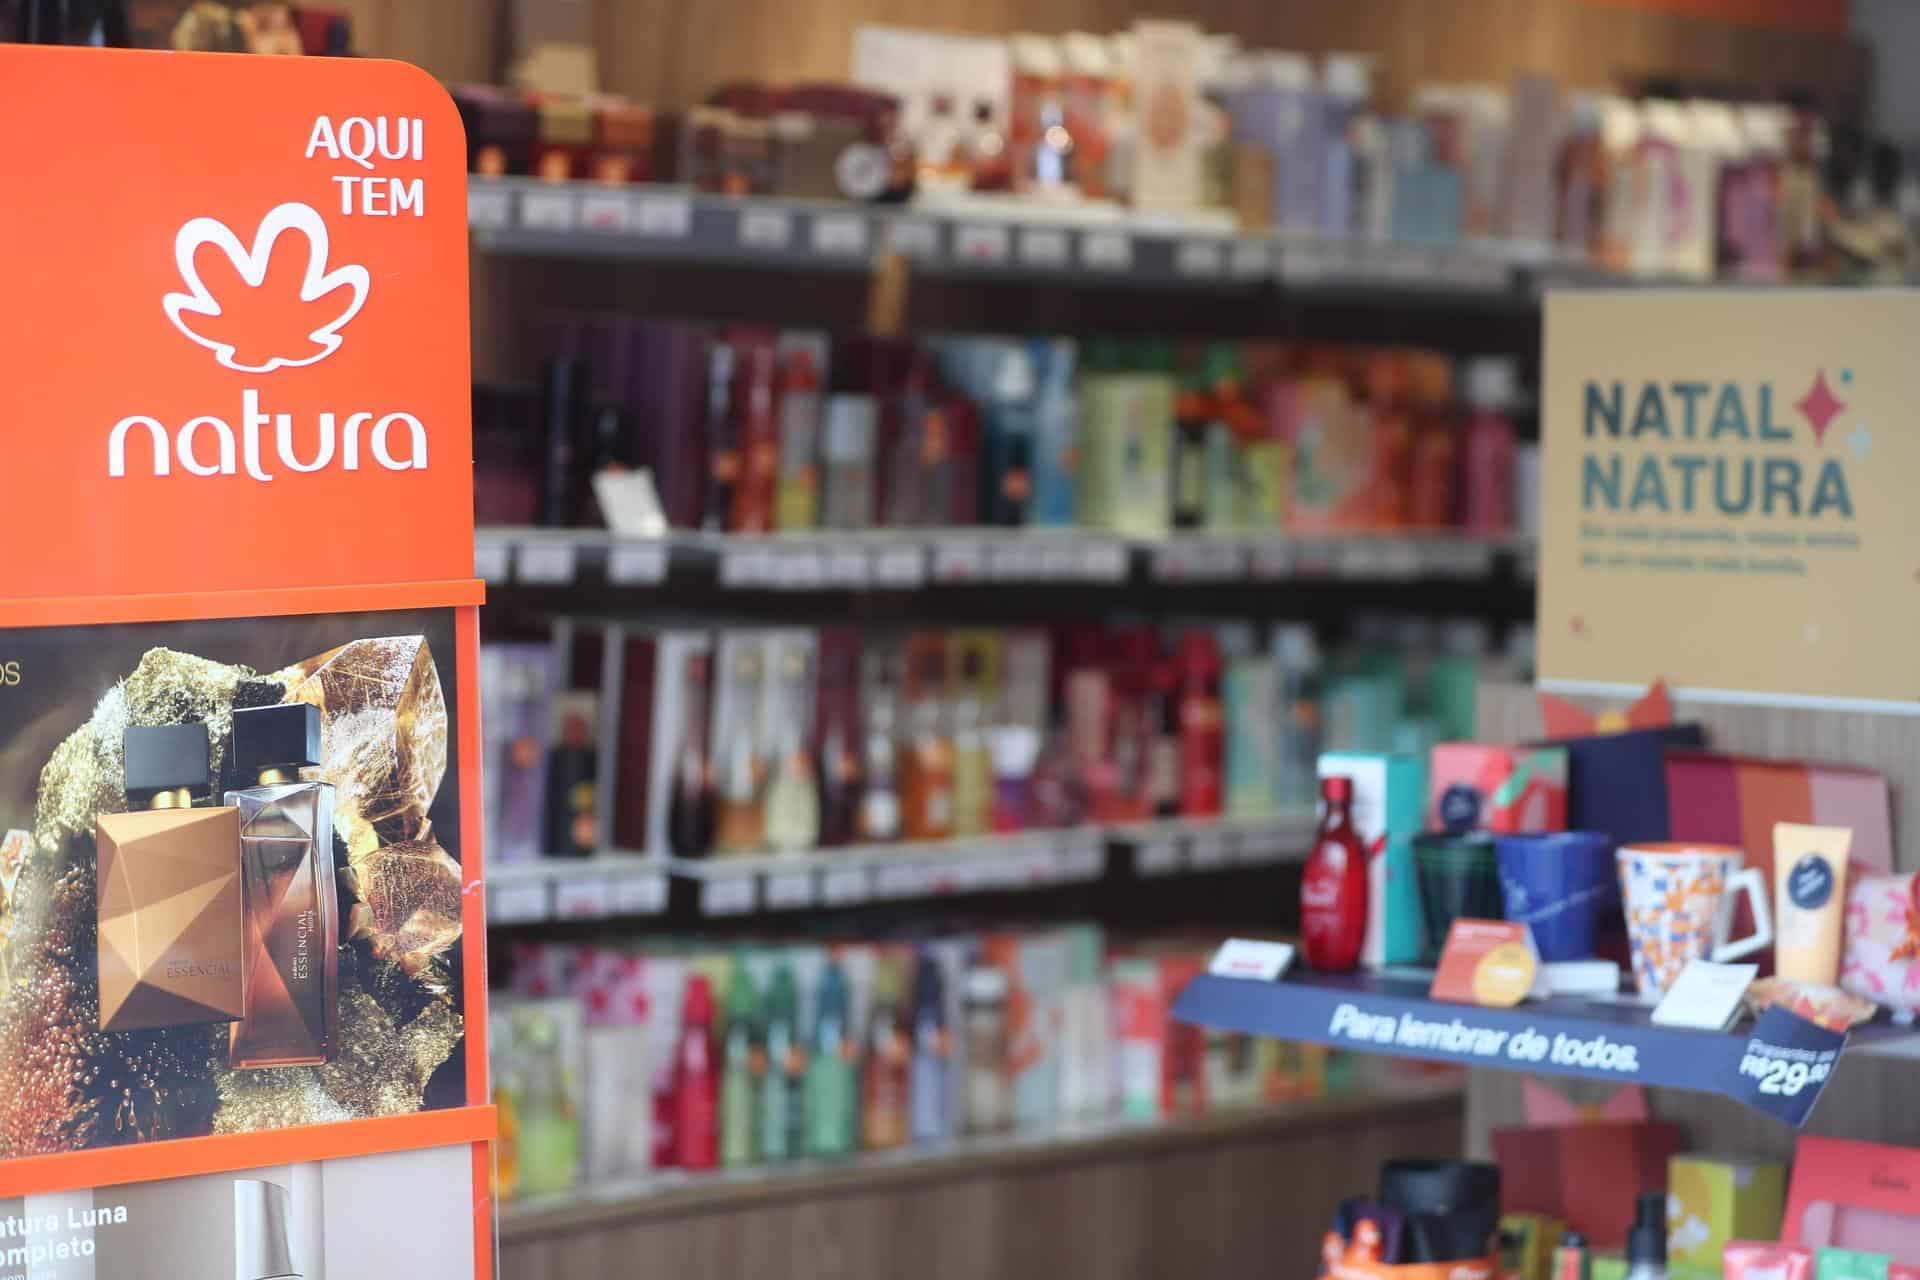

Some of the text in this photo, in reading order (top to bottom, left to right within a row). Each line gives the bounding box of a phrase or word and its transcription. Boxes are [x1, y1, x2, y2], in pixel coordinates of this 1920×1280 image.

[305, 115, 424, 169] AQUI
[332, 175, 424, 217] TEM
[108, 389, 428, 482] natura
[1582, 380, 1794, 441] NATAL
[1581, 454, 1854, 518] NATURA
[297, 911, 308, 980] ESSENCIAL
[1328, 1003, 1639, 1072] Para lembrar de todos.
[68, 1205, 128, 1229] Luna
